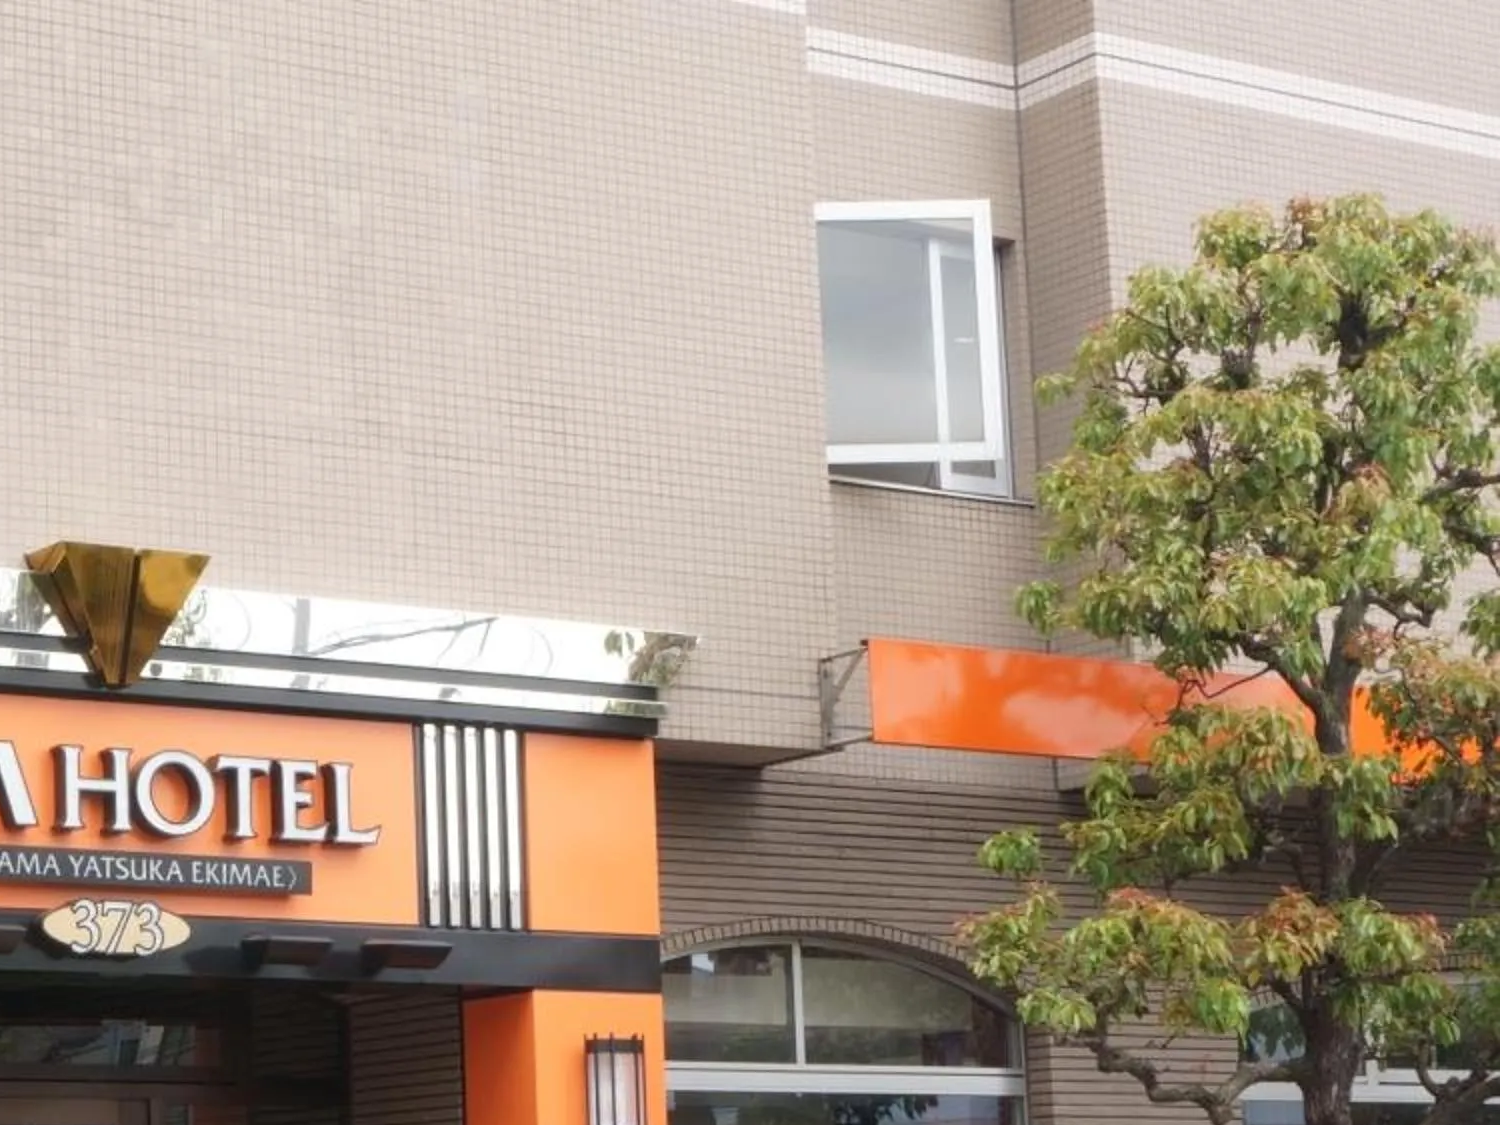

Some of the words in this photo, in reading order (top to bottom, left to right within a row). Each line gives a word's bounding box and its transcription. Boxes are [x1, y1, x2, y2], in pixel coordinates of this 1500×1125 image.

[52, 743, 382, 845] HOTEL
[68, 854, 184, 882] YATSUKA
[71, 899, 164, 956] 373
